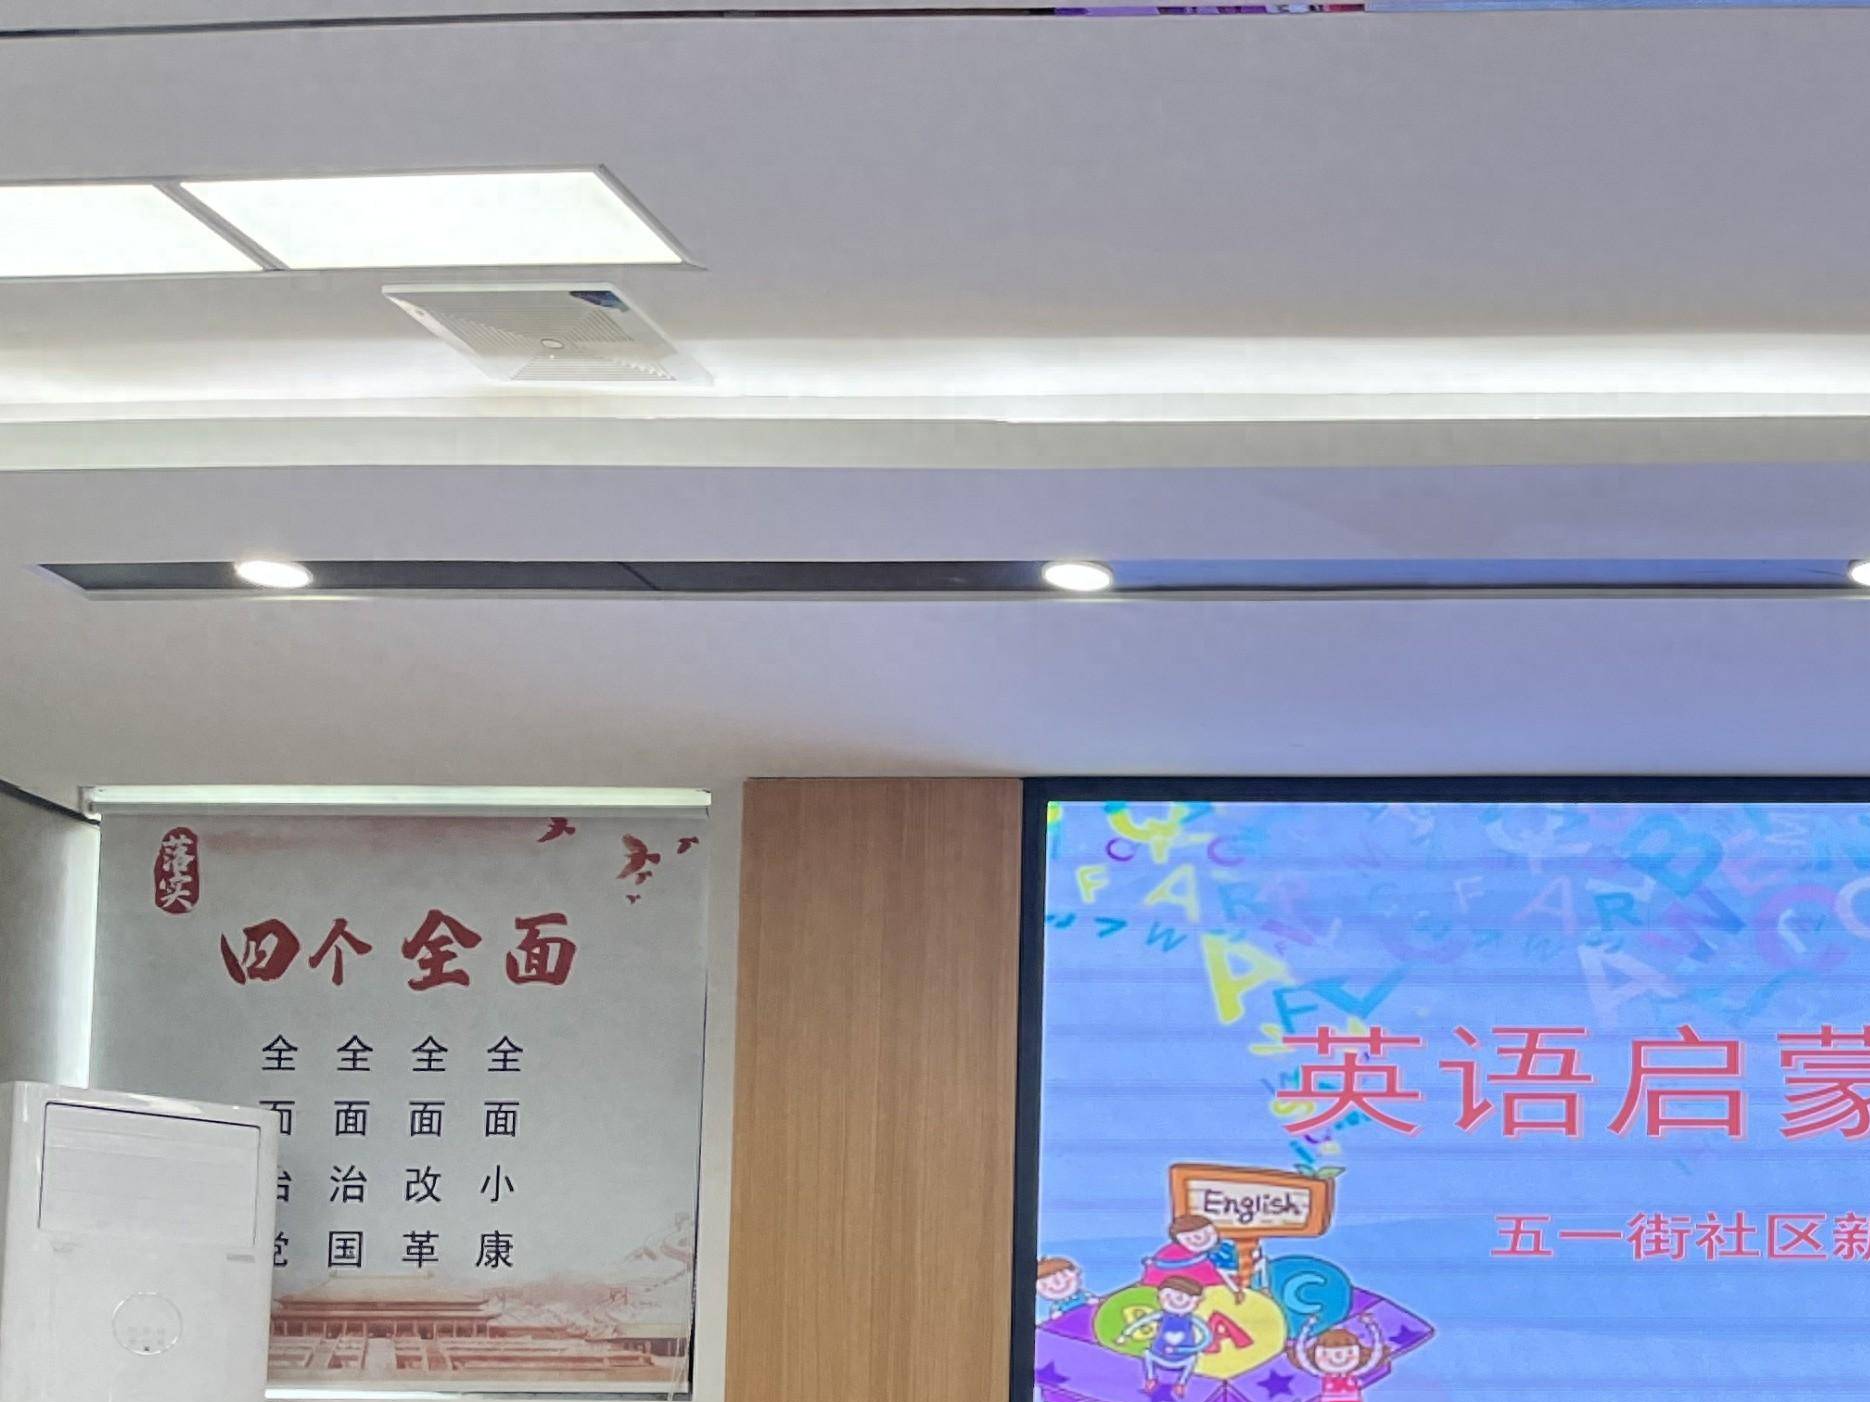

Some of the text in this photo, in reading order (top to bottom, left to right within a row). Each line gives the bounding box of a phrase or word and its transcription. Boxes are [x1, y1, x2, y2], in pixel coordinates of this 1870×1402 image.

[158, 832, 196, 912] 落实
[220, 909, 577, 991] 四个全面
[328, 1034, 374, 1268] 全面治国
[402, 1035, 448, 1268] 全面改革
[475, 1035, 524, 1268] 全面小康
[1203, 1188, 1300, 1225] English
